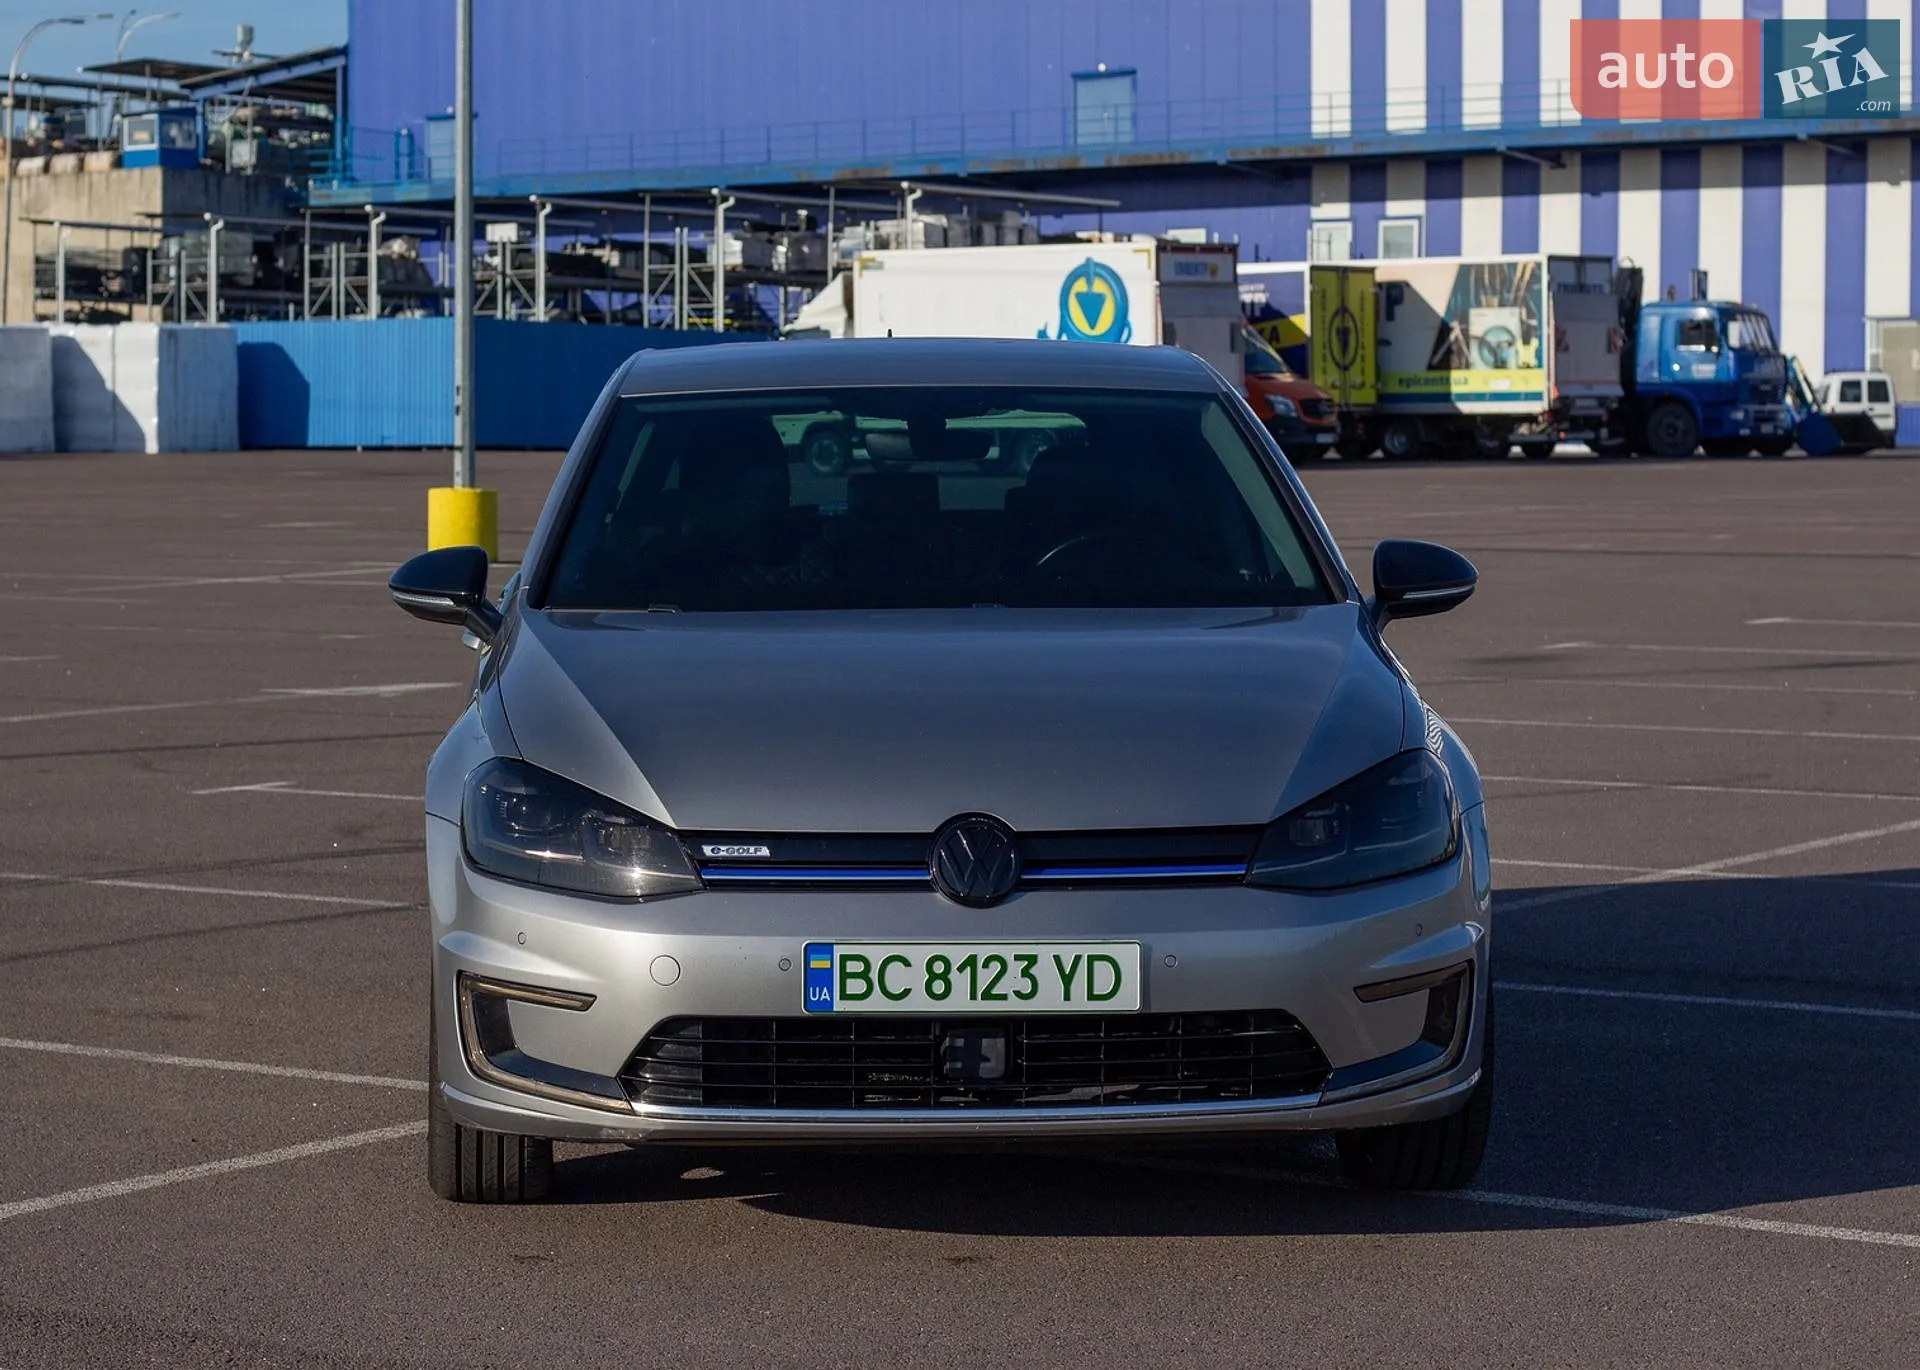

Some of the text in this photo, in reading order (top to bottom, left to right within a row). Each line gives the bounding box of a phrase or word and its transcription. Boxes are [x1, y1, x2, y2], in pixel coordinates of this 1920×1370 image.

[710, 846, 763, 855] e-GOLF
[838, 953, 1122, 1001] BC 8123 YD
[809, 986, 831, 1001] UA
